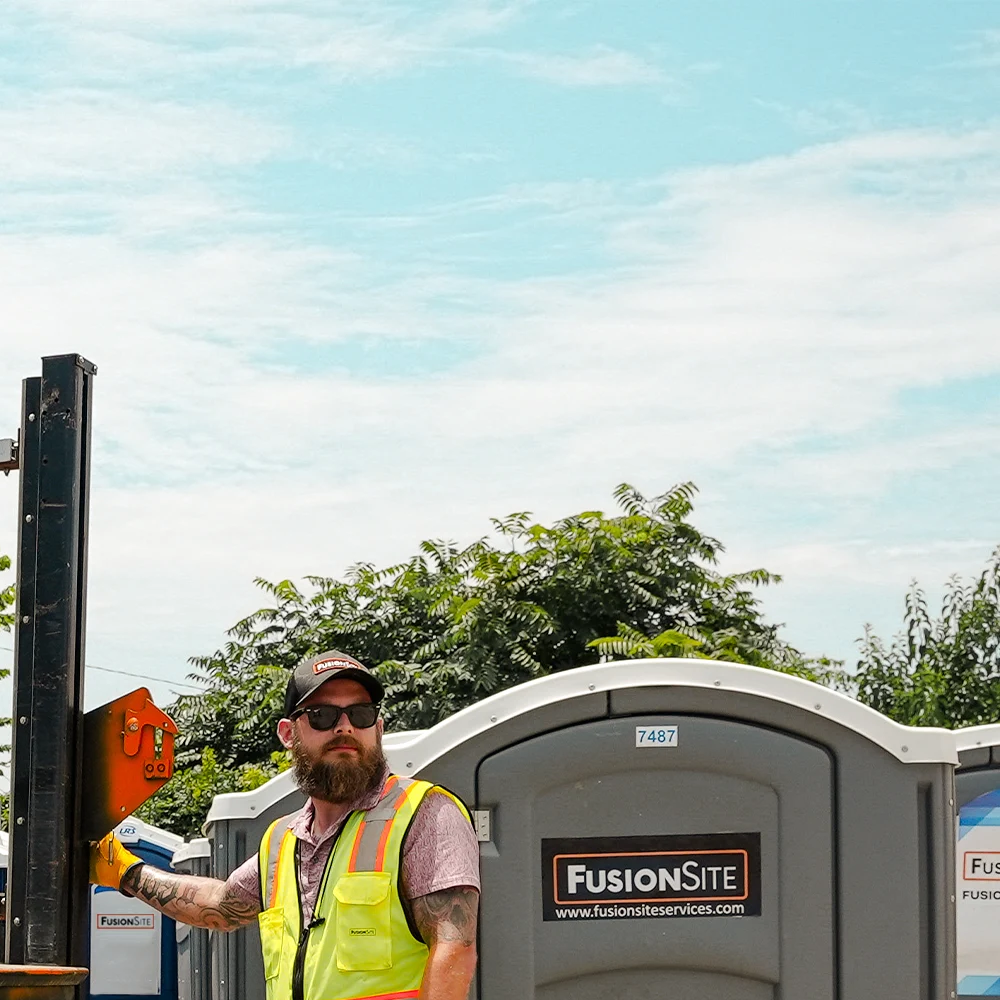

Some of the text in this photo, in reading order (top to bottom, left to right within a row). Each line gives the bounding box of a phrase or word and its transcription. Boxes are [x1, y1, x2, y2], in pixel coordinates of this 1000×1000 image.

[638, 730, 676, 743] 7487
[567, 860, 737, 894] FUSIONSITE
[555, 903, 745, 918] www.fusionsiteservices.com
[100, 916, 152, 926] FUSIONSITE
